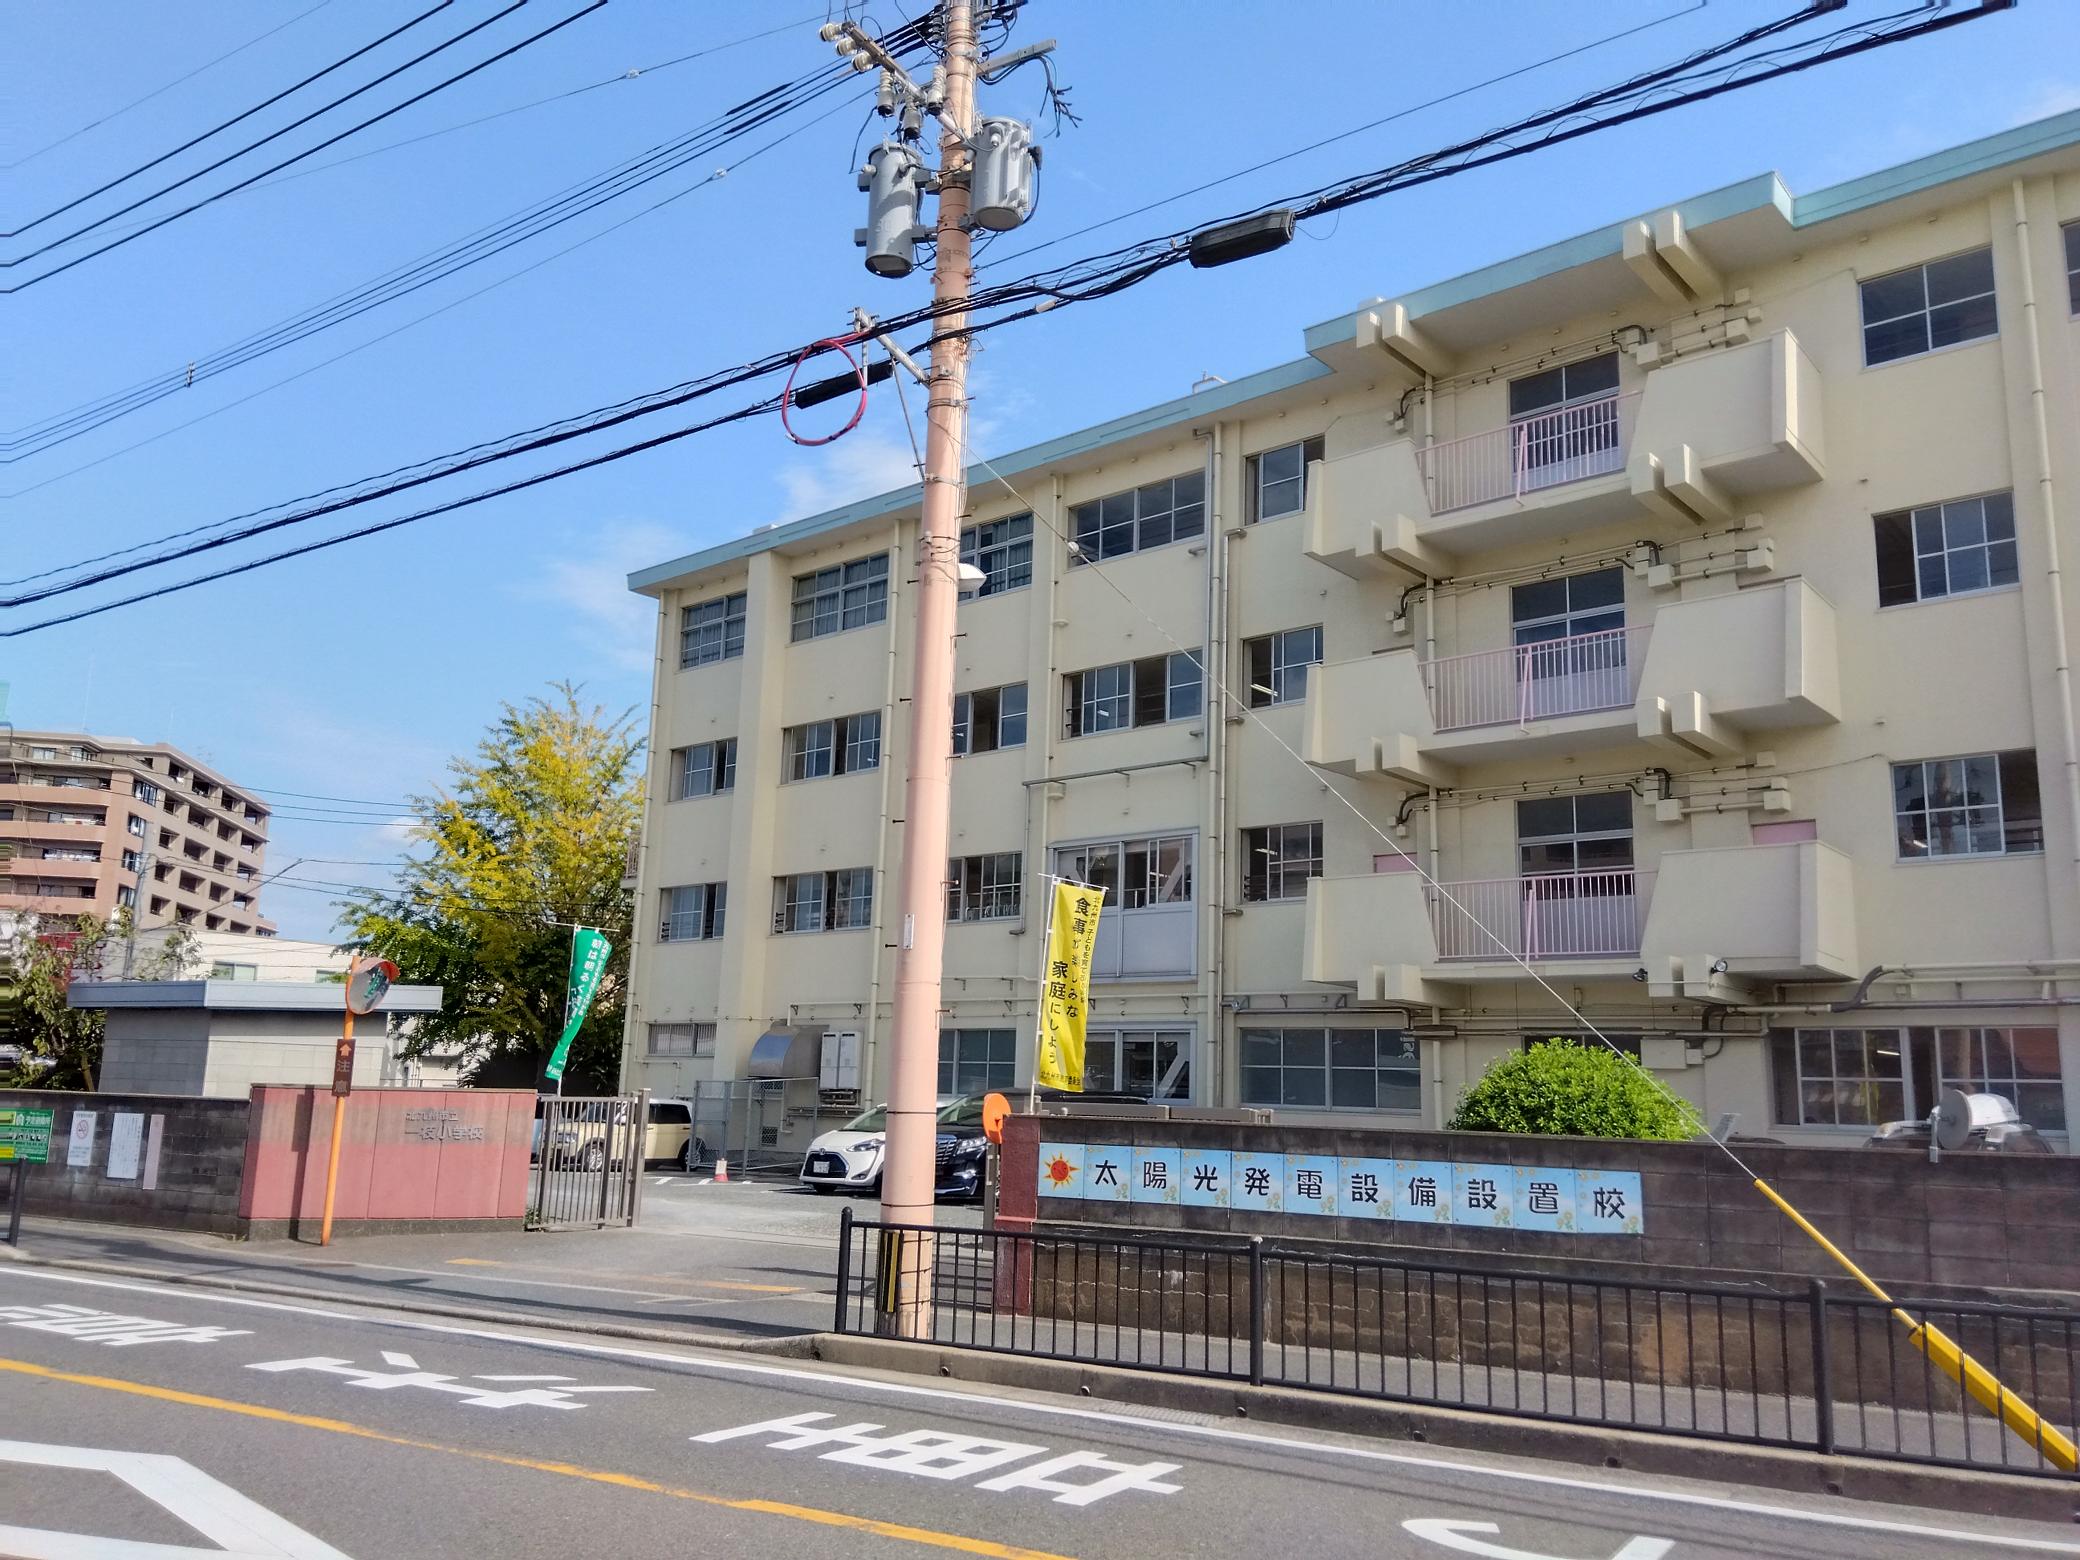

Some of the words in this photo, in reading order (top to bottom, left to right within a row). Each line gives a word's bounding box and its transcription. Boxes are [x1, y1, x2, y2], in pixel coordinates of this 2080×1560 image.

[1048, 960, 1069, 1064] 家庭にしよう
[1093, 1161, 1626, 1220] 太陽光発電設備設置校
